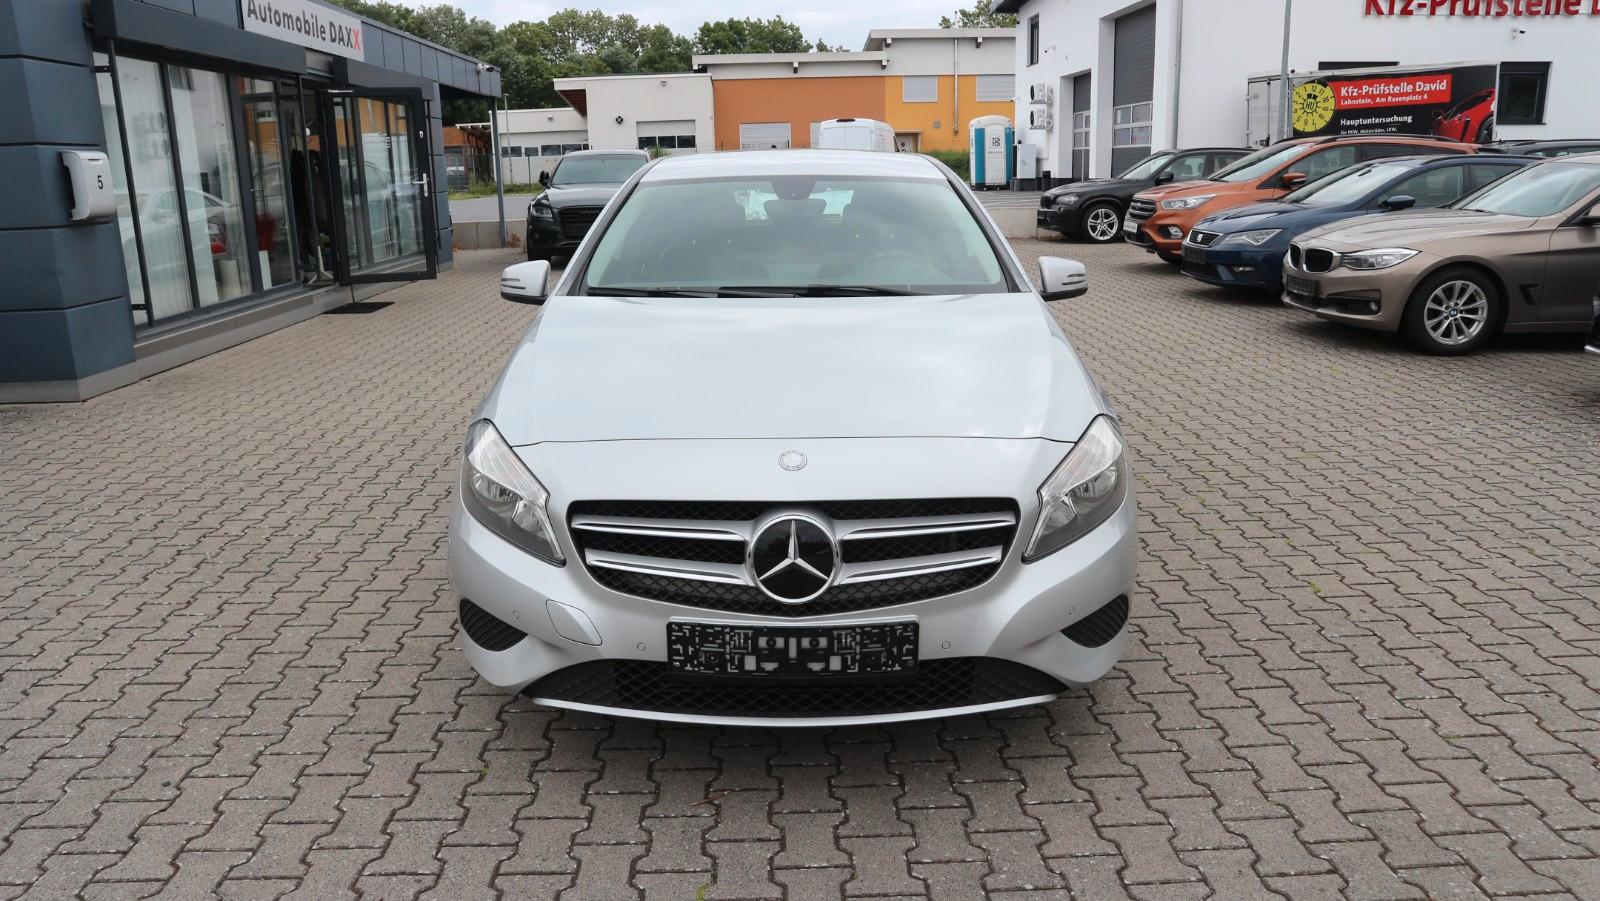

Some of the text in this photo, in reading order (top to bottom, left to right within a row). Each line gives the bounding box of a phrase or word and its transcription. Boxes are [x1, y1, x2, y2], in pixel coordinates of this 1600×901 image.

[247, 0, 361, 51] Automobile DAXX
[1340, 79, 1447, 97] Kfz-Prüfstelle David
[1340, 97, 1374, 105] Lahnstein,
[1387, 94, 1422, 103] Rasenplatz
[1340, 115, 1413, 127] Hauptuntersuchung
[97, 175, 104, 190] 5
